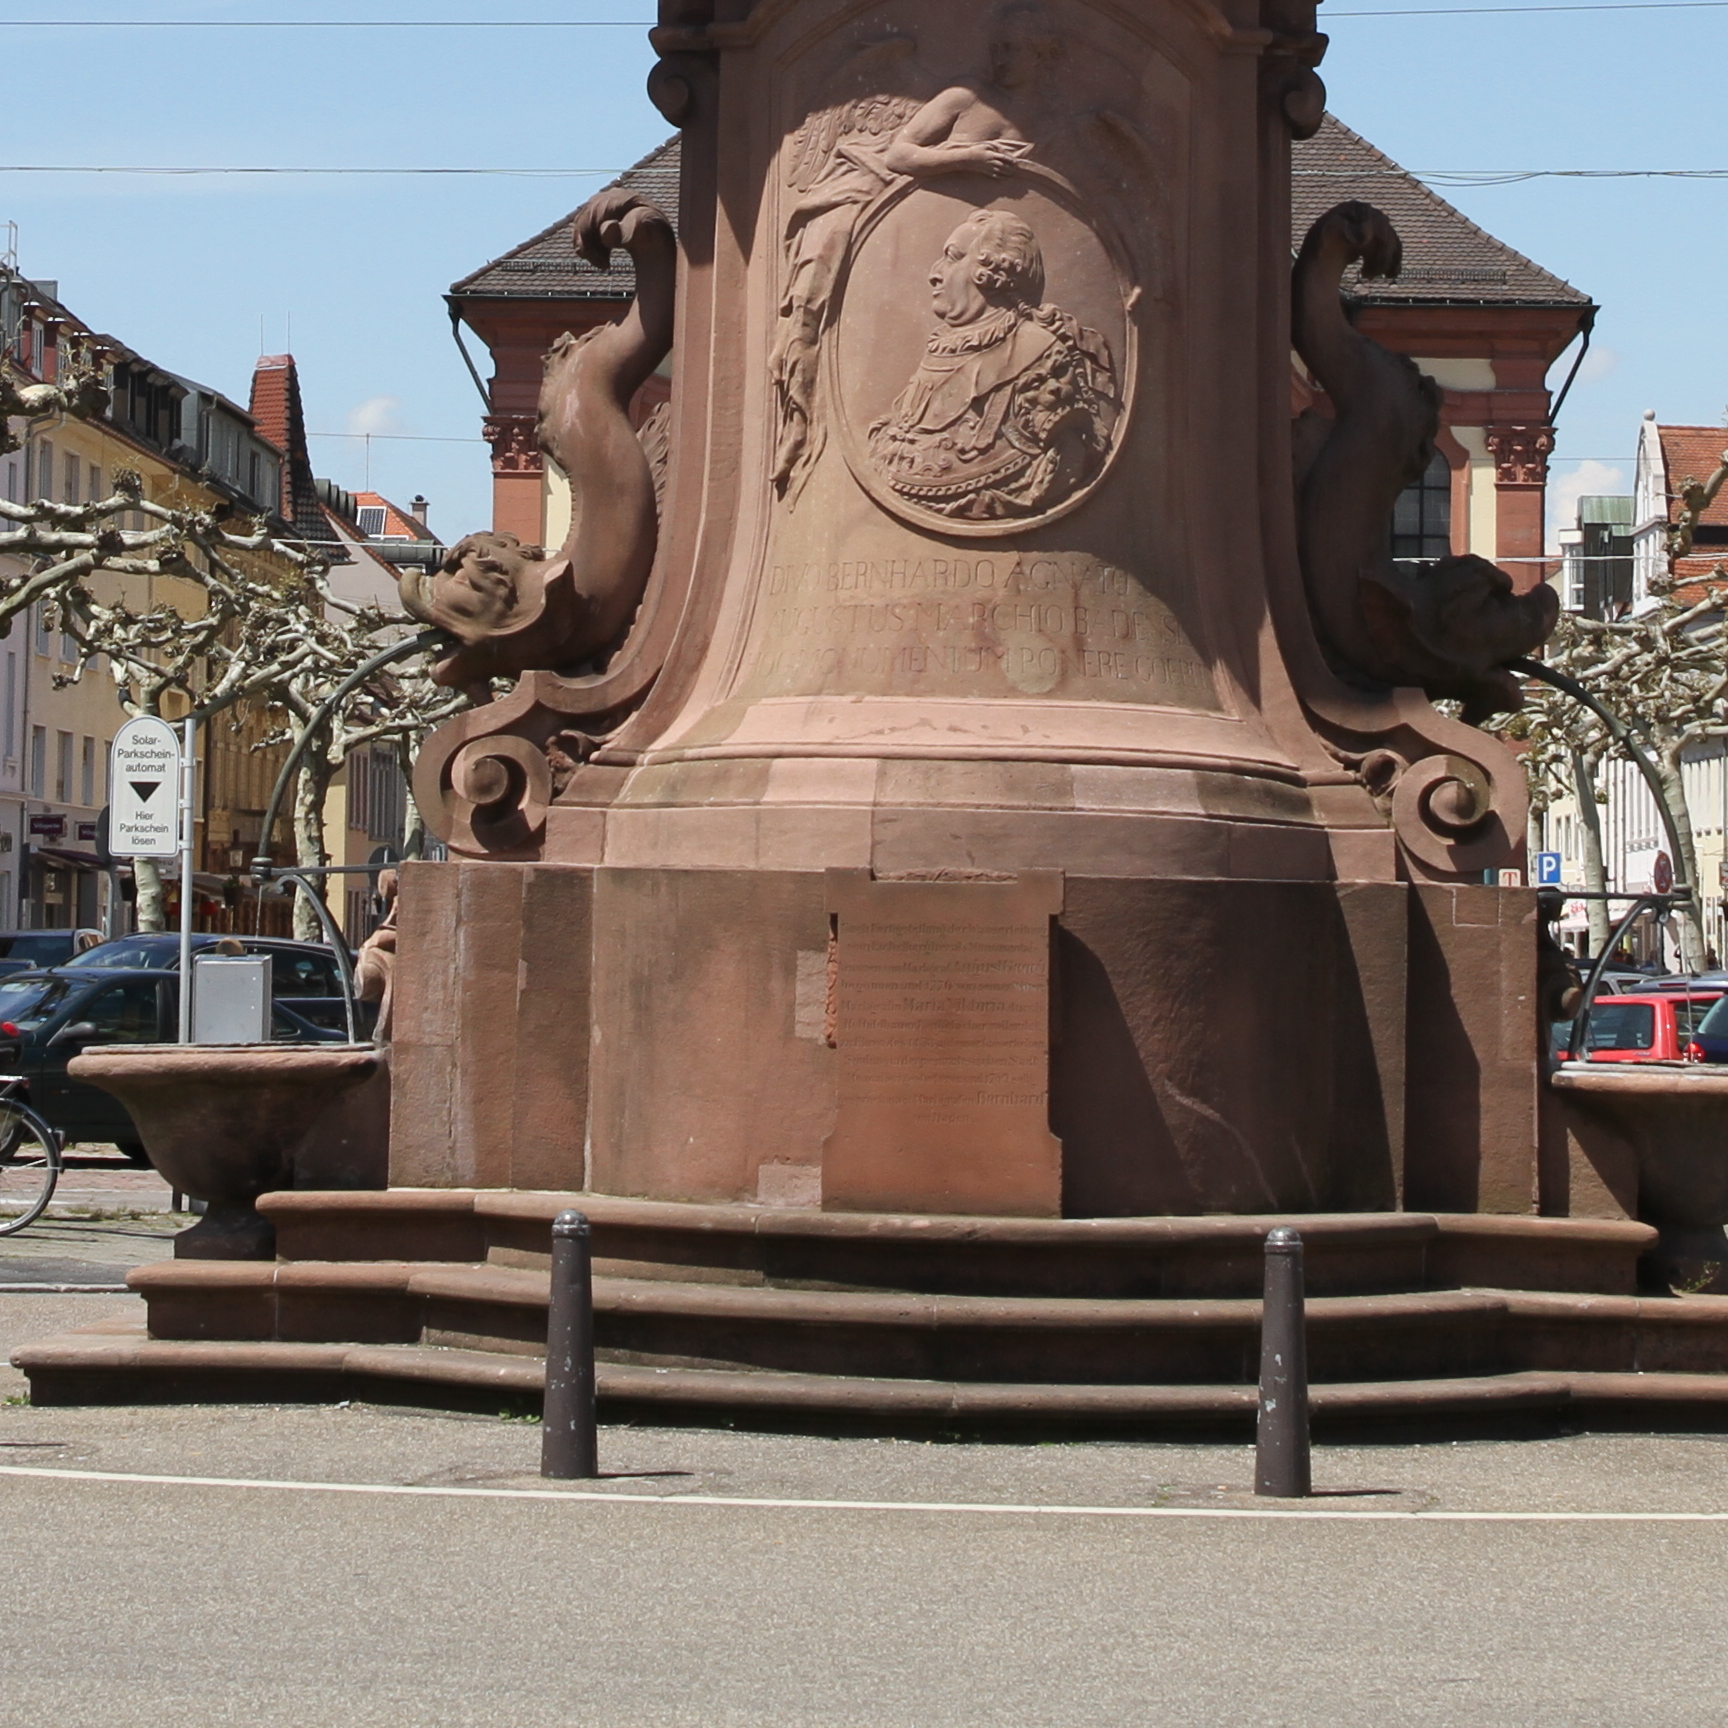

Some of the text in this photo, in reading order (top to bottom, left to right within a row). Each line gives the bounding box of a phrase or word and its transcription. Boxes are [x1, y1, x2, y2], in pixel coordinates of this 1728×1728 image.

[826, 558, 995, 592] BERNHARDO
[1003, 560, 1129, 595] AGNATO
[768, 602, 906, 636] AUGUSTUS
[915, 602, 1064, 634] MARCHIO
[1020, 647, 1130, 680] PONERE
[132, 735, 162, 745] Solar-
[117, 748, 176, 759] Parkschein-
[125, 763, 166, 773] automat
[135, 811, 154, 821] Hier
[119, 824, 169, 833] Parkschein
[131, 835, 156, 845] lösen
[1542, 856, 1557, 881] P
[904, 997, 946, 1012] Maria
[977, 1090, 1044, 1105] Bernhard
